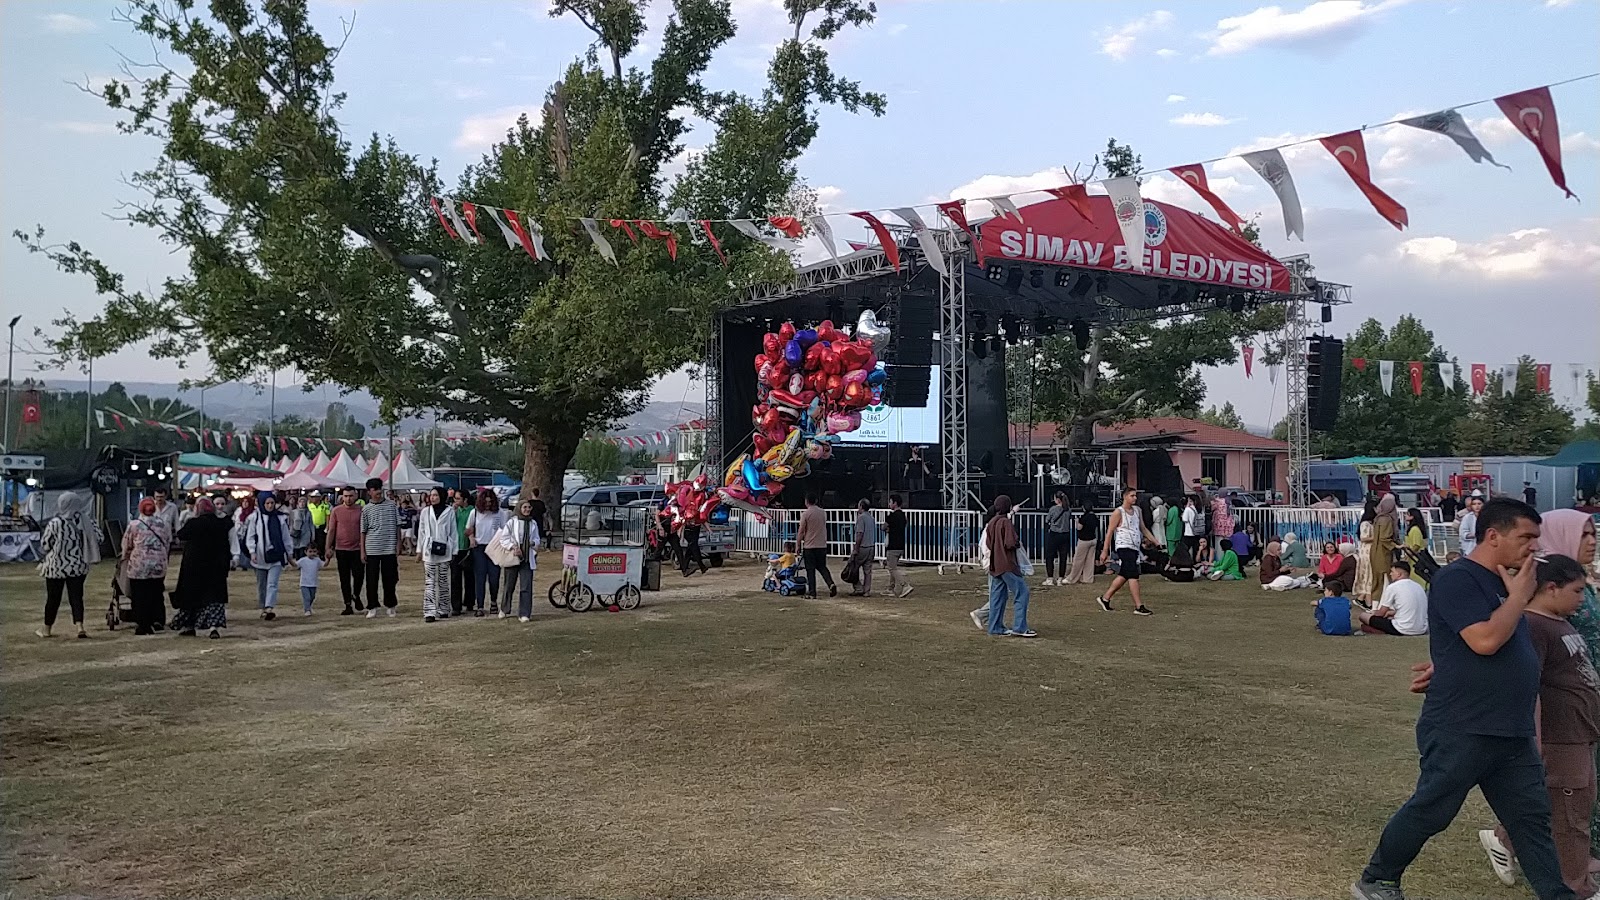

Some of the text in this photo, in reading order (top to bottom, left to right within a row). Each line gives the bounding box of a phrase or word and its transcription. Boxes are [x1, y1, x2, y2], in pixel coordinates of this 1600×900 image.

[1000, 227, 1273, 289] SİMAV BELEDİYESİ
[866, 413, 881, 421] 1867
[592, 555, 622, 565] GÜNGÖR
